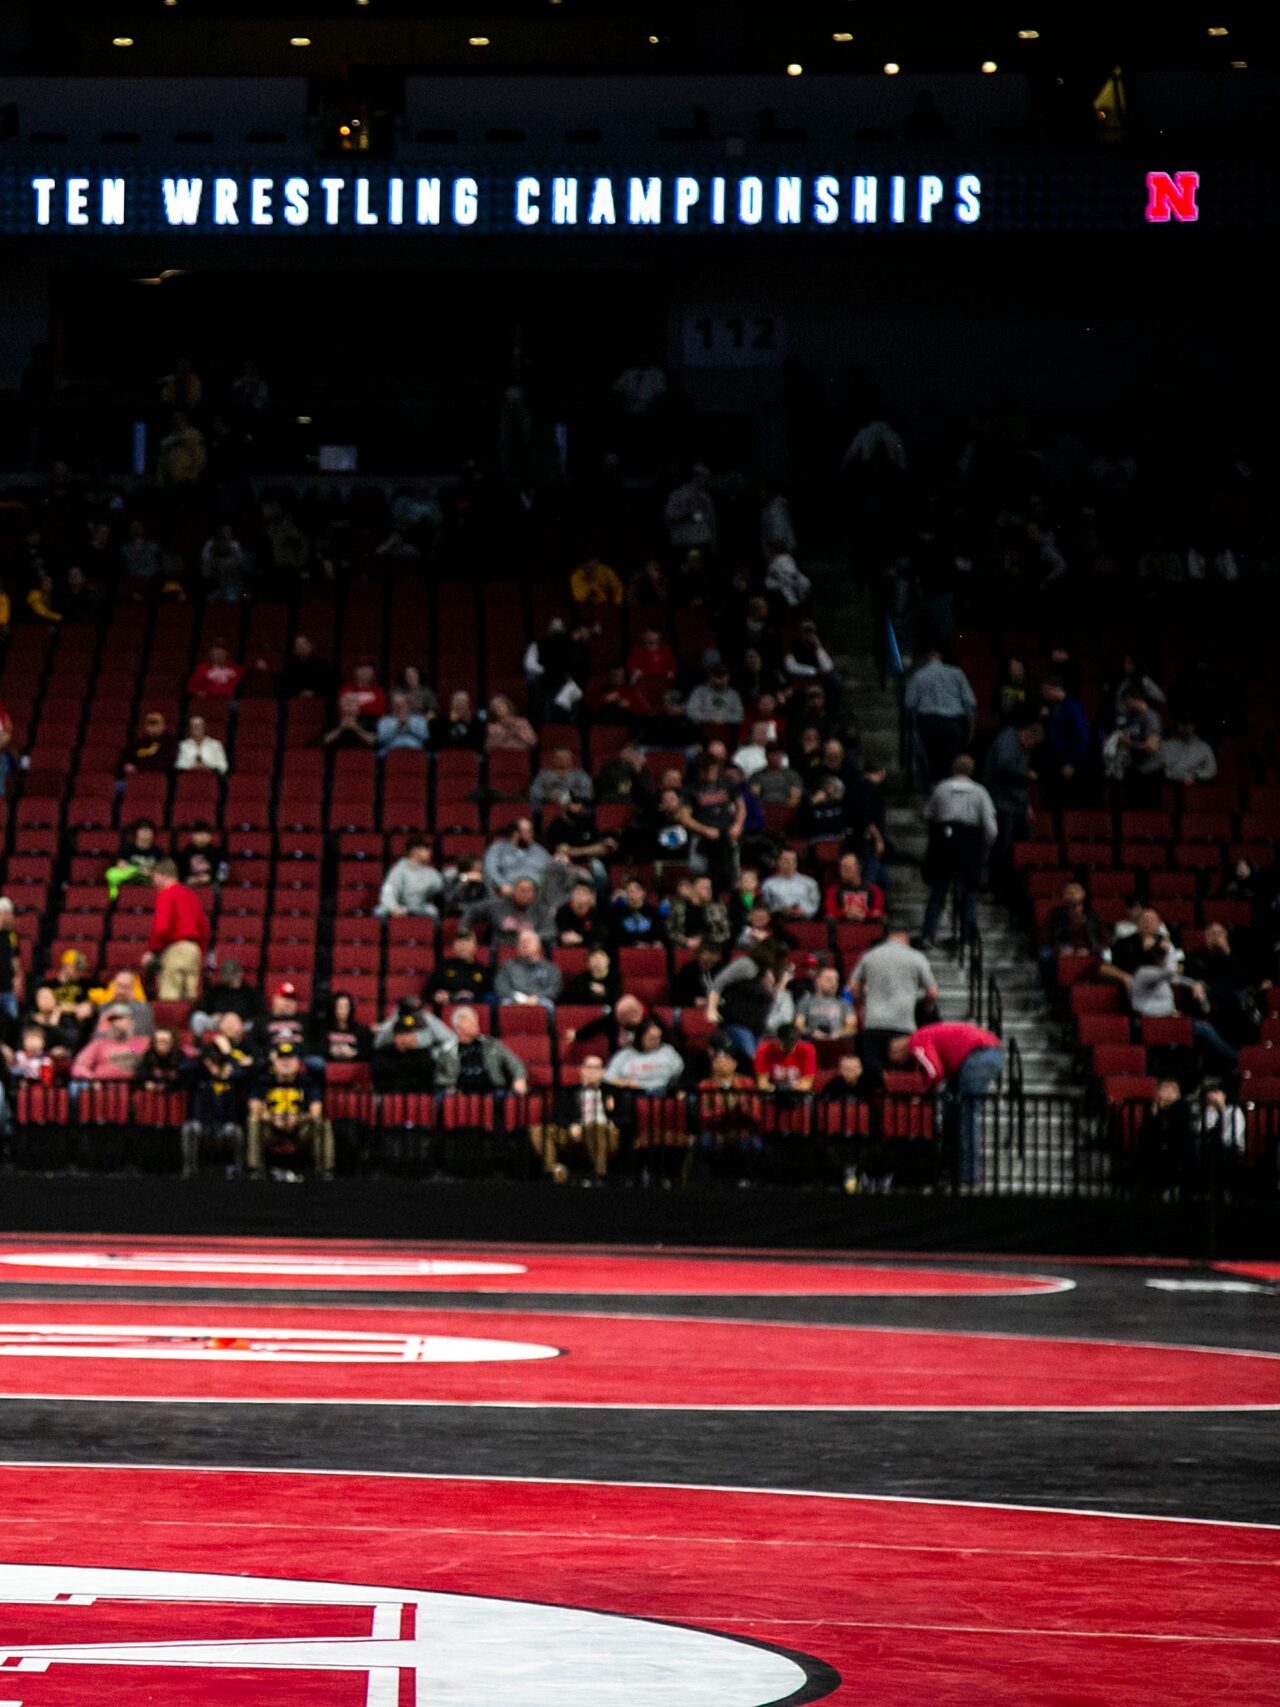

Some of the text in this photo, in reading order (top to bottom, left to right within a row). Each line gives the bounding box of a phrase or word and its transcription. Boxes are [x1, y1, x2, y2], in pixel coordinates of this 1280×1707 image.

[31, 176, 125, 226] TEN
[160, 176, 479, 227] WRESTLING
[513, 174, 982, 227] CHAMPIONSHIPS
[1144, 170, 1200, 223] N
[696, 318, 776, 348] 112
